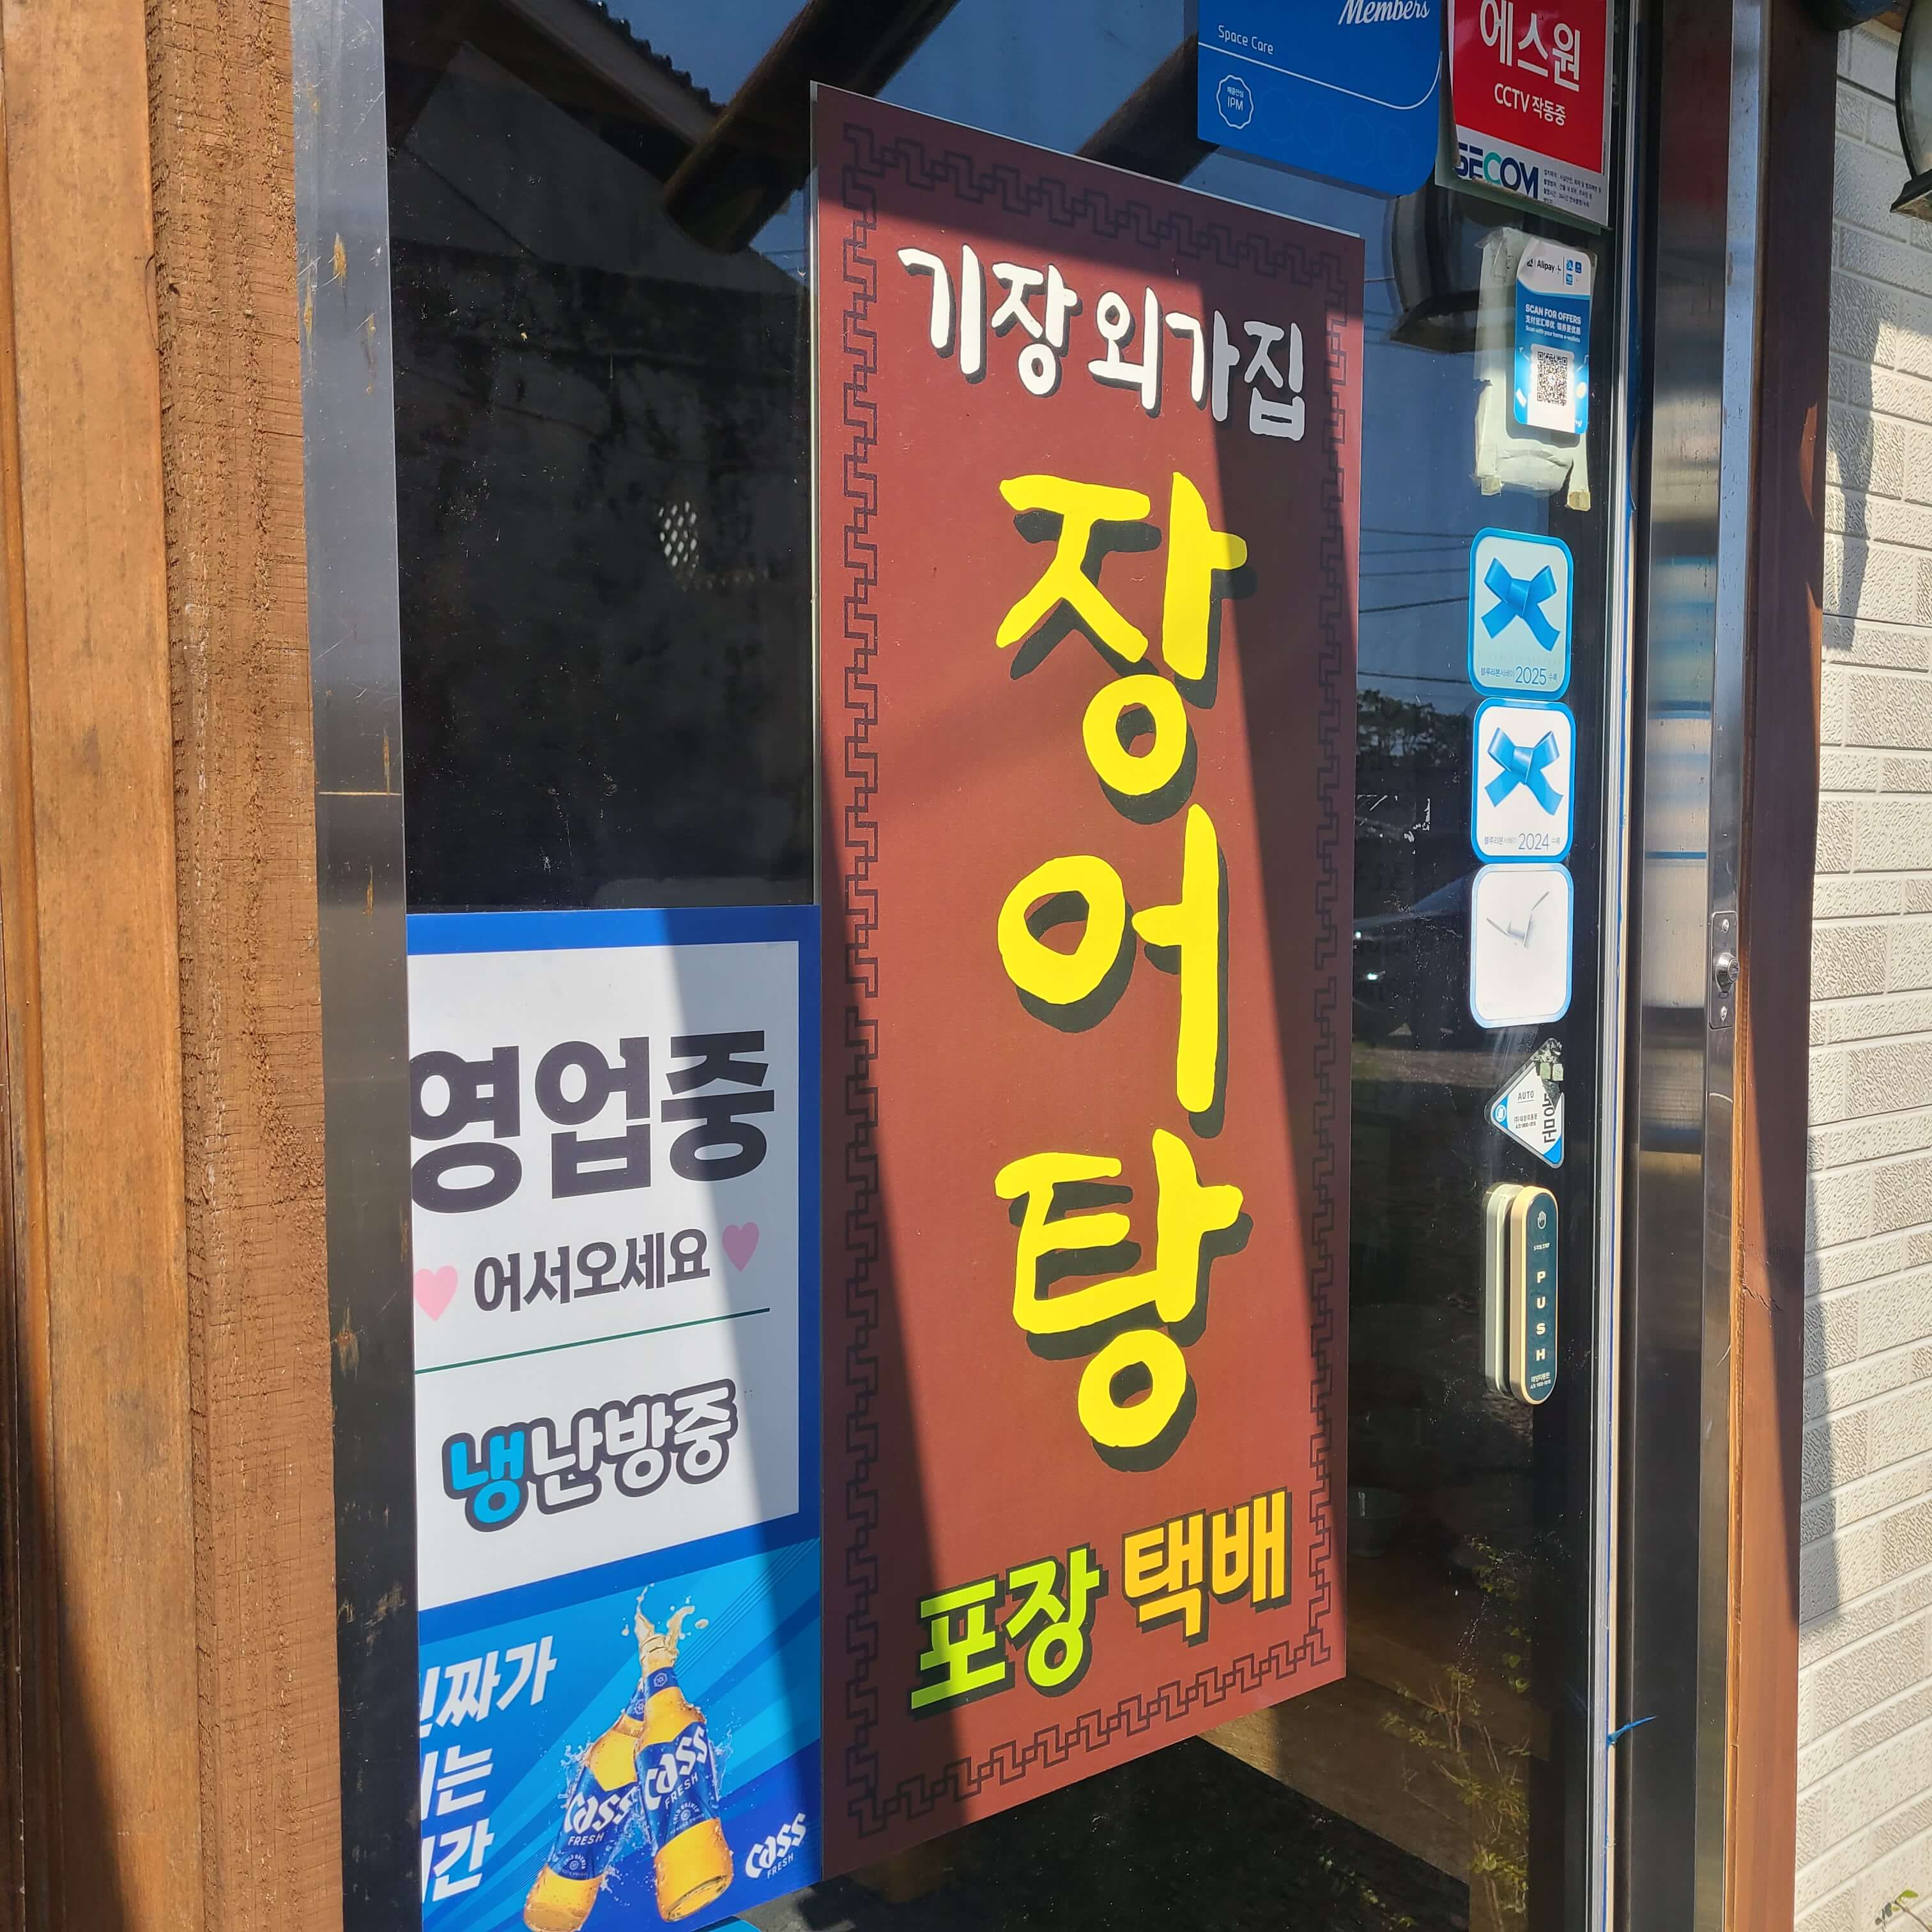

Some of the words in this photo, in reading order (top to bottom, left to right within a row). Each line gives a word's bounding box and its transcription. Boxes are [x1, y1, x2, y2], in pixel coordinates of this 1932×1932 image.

[1338, 0, 1430, 25] Members
[1218, 24, 1248, 47] Space
[1252, 36, 1274, 54] Care
[1480, 0, 1580, 92] 에스원
[1227, 96, 1243, 111] IPM
[1494, 83, 1530, 113] CCTV
[1532, 95, 1566, 126] 작동중
[1525, 303, 1544, 316] SCAN
[1544, 307, 1557, 319] FOR
[1558, 312, 1581, 325] OFFERS
[898, 244, 1078, 397] 기장
[1087, 287, 1305, 442] 외가집
[1515, 666, 1547, 686] 2025
[1518, 832, 1549, 850] 2024
[994, 471, 1246, 1449] 장어탕
[1517, 1090, 1535, 1101] AUTO
[410, 1030, 775, 1214] 영업중
[474, 1229, 710, 1312] 어서오세요
[1536, 1271, 1547, 1361] PUSH
[442, 1378, 738, 1532] 냉난방중
[911, 1547, 1101, 1710] 포장
[1124, 1491, 1285, 1637] 택배
[664, 1772, 699, 1810] FRESH
[567, 1832, 605, 1846] FRESH
[767, 1852, 794, 1880] FRESH
